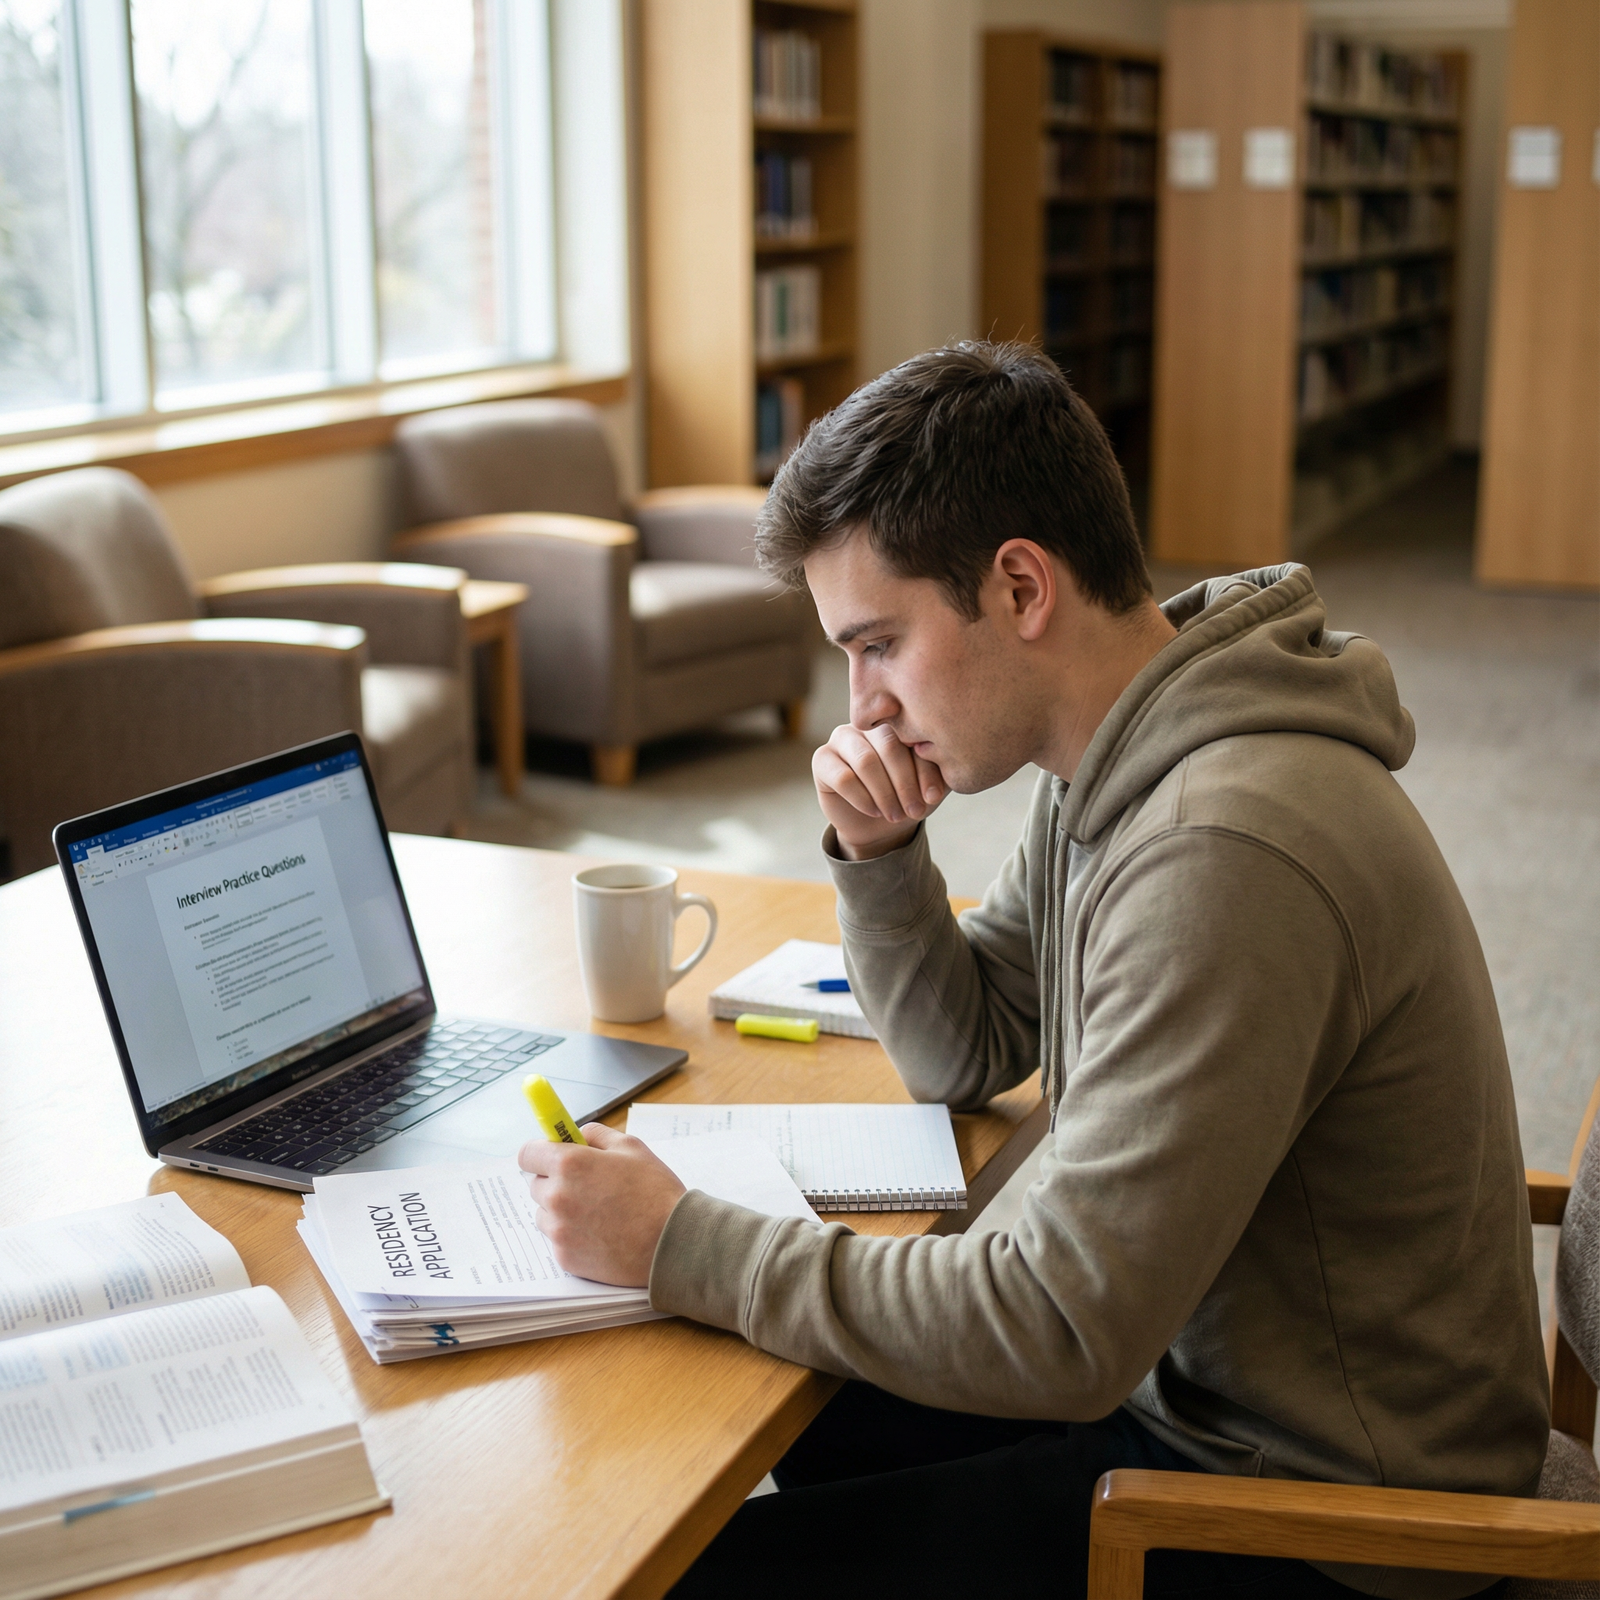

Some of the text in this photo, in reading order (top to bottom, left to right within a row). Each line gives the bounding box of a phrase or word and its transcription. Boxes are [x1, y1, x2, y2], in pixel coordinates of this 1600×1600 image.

[176, 854, 306, 909] Interview Practice Questions
[367, 1205, 417, 1277] RESIDENCY
[399, 1192, 454, 1279] APPLICATION
